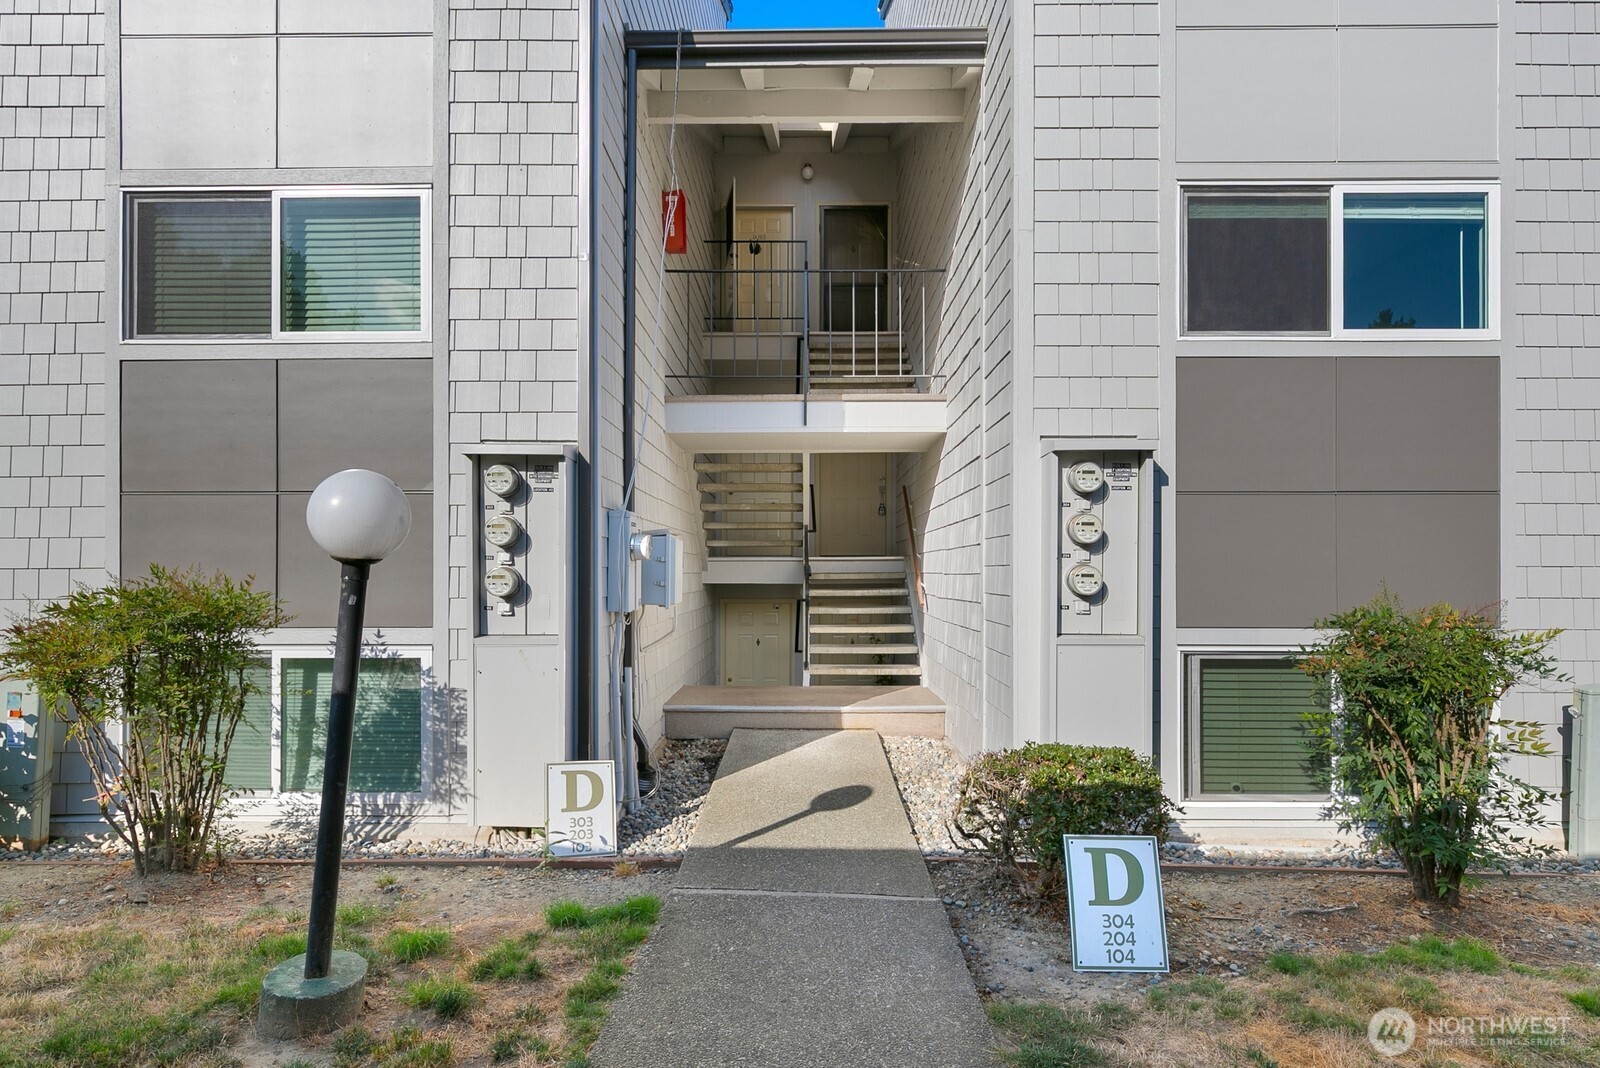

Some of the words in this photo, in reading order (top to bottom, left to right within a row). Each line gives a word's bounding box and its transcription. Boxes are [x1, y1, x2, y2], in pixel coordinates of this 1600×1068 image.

[561, 770, 604, 812] D
[569, 817, 593, 828] 303
[569, 829, 593, 841] 203
[572, 842, 592, 853] 103
[1084, 847, 1145, 906] D
[1102, 914, 1135, 929] 304
[1103, 931, 1136, 946] 204
[1106, 949, 1136, 964] 104
